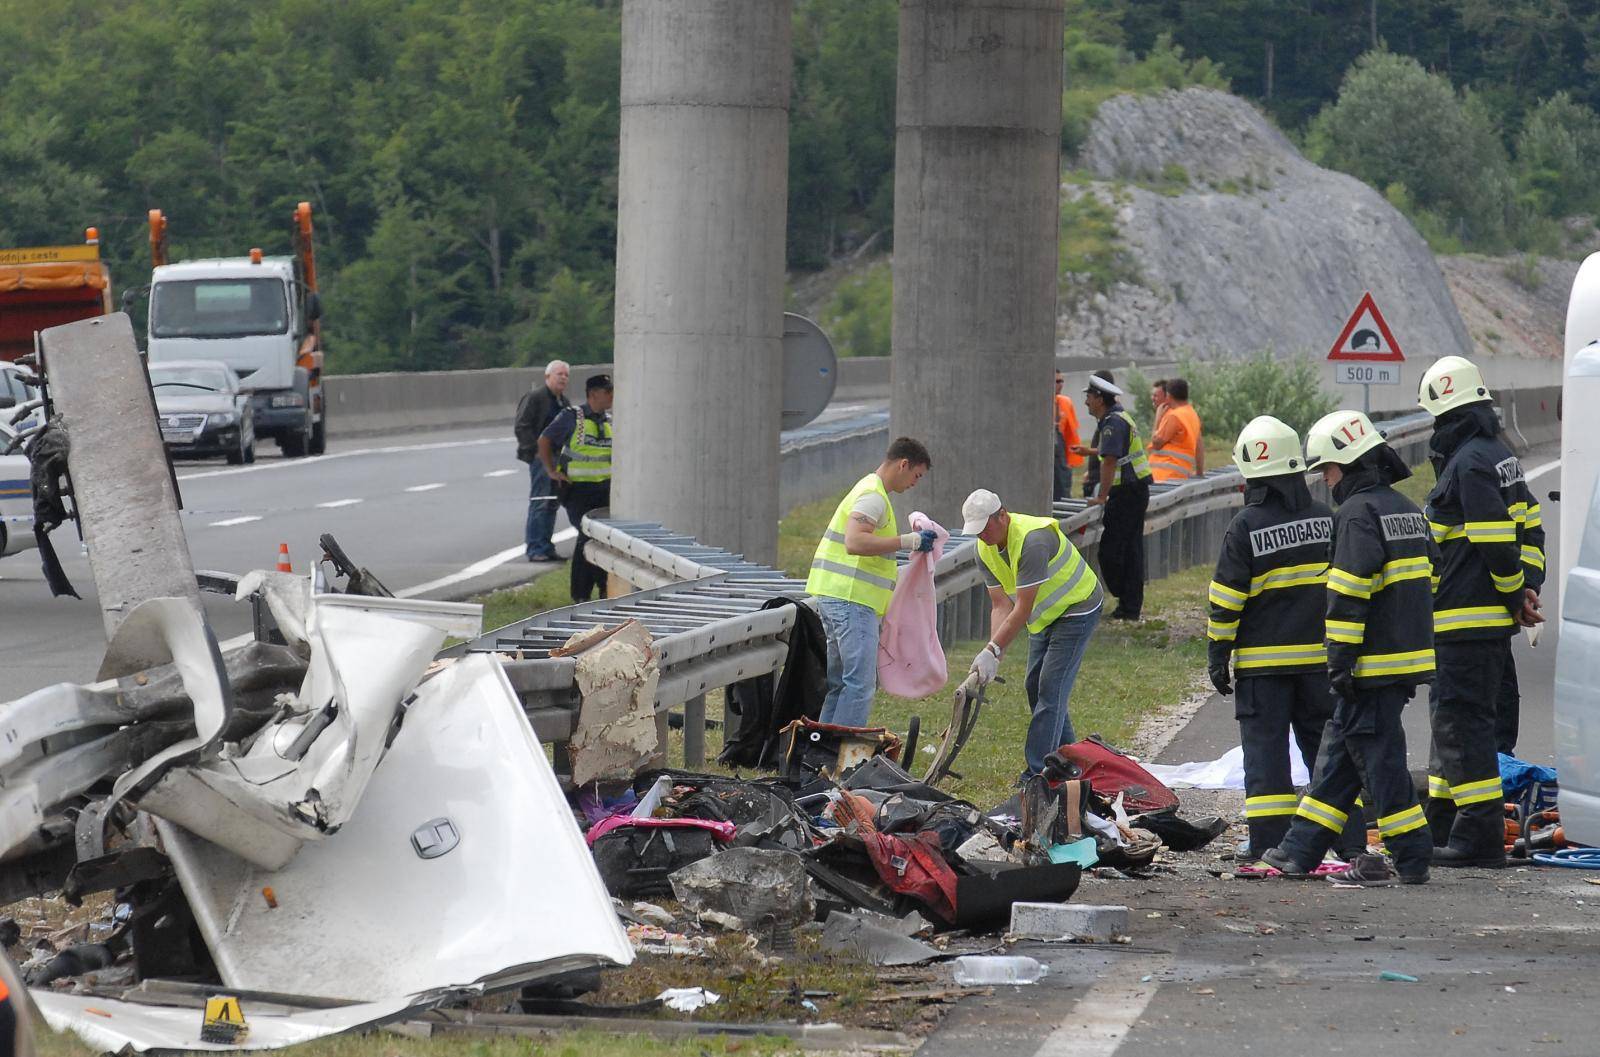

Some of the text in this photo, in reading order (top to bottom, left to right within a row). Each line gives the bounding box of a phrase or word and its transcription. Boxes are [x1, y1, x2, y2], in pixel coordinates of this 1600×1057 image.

[1347, 367, 1390, 381] 500 m
[1439, 376, 1454, 395] 2
[1340, 419, 1365, 443] 17
[1255, 441, 1269, 461] 2
